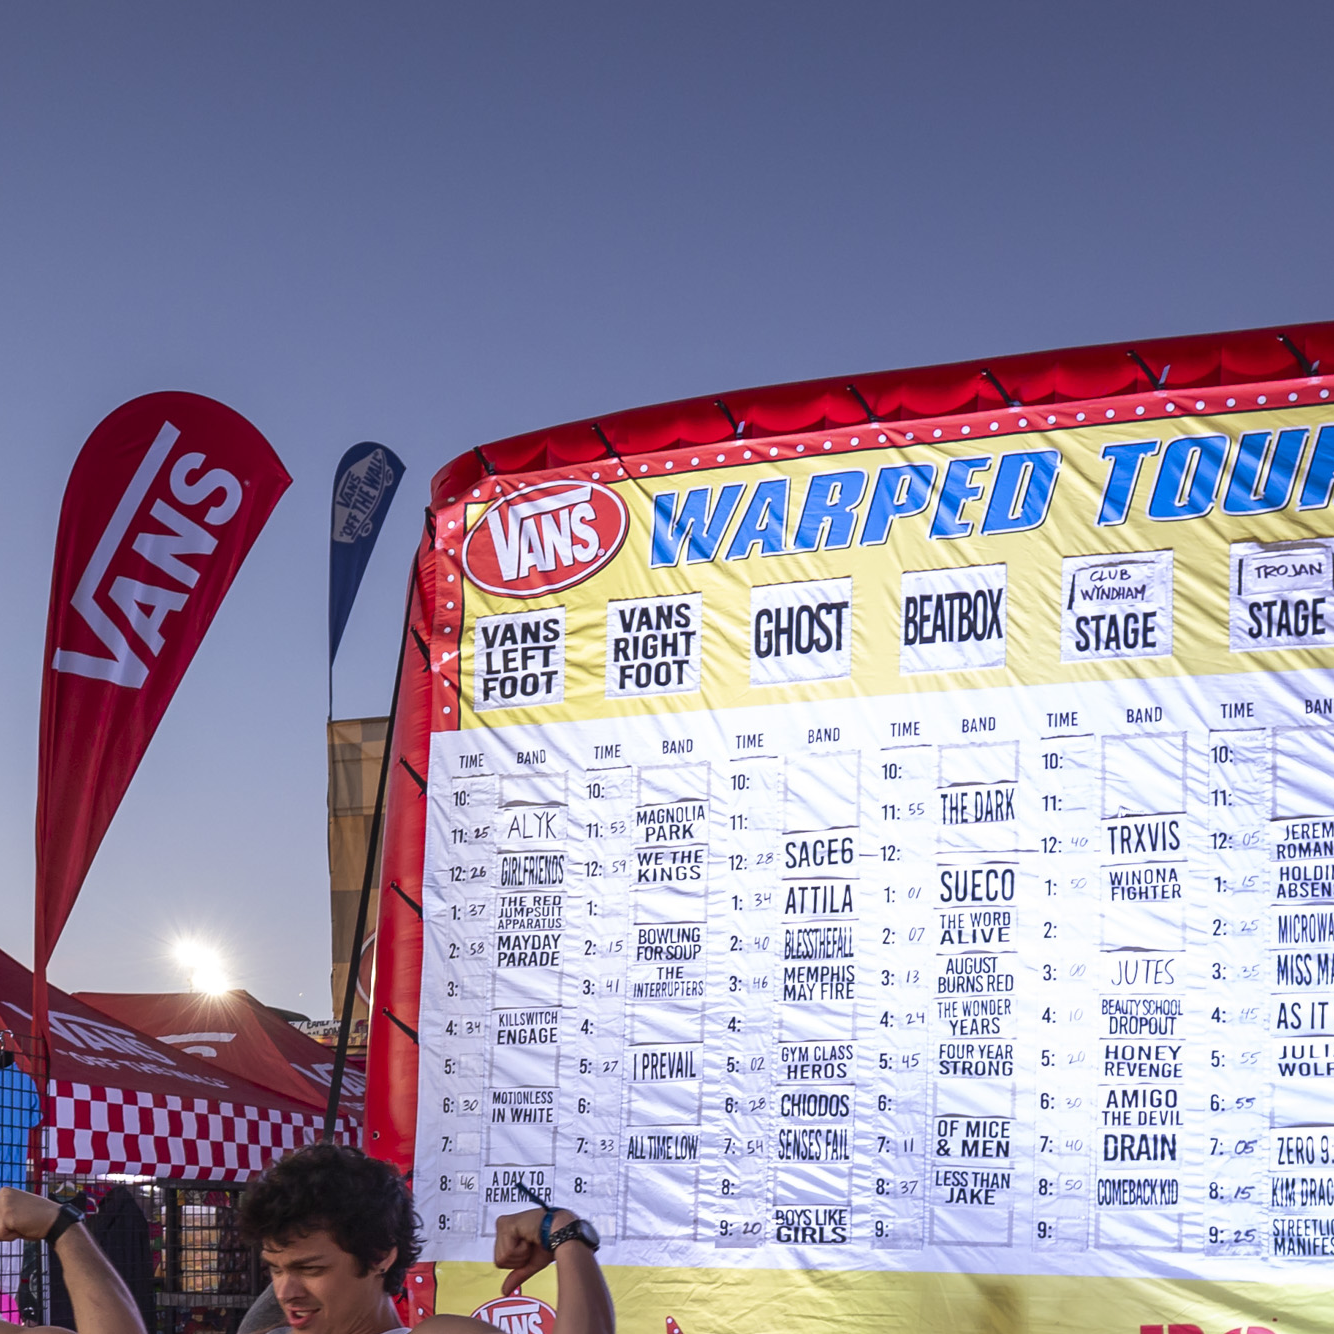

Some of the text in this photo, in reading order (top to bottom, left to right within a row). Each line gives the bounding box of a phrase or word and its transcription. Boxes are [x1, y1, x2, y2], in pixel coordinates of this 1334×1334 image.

[335, 470, 362, 509] VANS
[351, 485, 376, 515] THE
[649, 448, 1063, 570] WARPED
[487, 485, 604, 582] VANS
[53, 420, 244, 689] VANS
[1089, 569, 1132, 582] CLUB
[1254, 562, 1323, 579] TROJAN
[1080, 582, 1147, 602] WYNDHAM
[618, 602, 691, 633] VANS
[904, 588, 1004, 646] BEATBOX
[1248, 598, 1326, 639] STAGE
[482, 618, 560, 646] VANS
[755, 601, 849, 658] GHOST
[1076, 612, 1158, 652] STAGE
[613, 631, 696, 663] RIGHT
[485, 647, 558, 675] LEFT
[618, 660, 689, 690] FOOT
[482, 675, 558, 701] FOOT
[460, 750, 546, 768] TIME BAND
[636, 805, 705, 825] MAGNOLIA
[941, 788, 1015, 825] THE DARK
[508, 811, 558, 839] ALYK
[586, 822, 626, 838] 11: 53
[645, 824, 694, 842] PARK
[1108, 820, 1180, 855] TRXVIS
[638, 849, 703, 866] WE THE
[785, 837, 853, 868] SACE6
[501, 855, 565, 886] GIRLFRIENDS
[638, 865, 701, 882] KINGS
[1109, 868, 1178, 886] WINONA
[940, 869, 1015, 902] SUECO
[1111, 884, 1181, 901] FIGHTER
[501, 895, 562, 907] THE RED
[785, 885, 853, 914] ATTILA
[499, 906, 563, 917] JUMPSUIT
[498, 918, 562, 929] APPARATUS
[449, 941, 485, 958] 2: 58
[784, 965, 855, 984] MEMPHIS
[946, 957, 998, 974] AUGUST
[1111, 958, 1175, 985] JUTES
[784, 983, 854, 1001] MAY FIRE
[938, 975, 1014, 993] BURNS RED
[499, 1012, 558, 1027] KILLSWITCH
[1277, 1002, 1301, 1029] AS
[1311, 1002, 1328, 1029] IT
[497, 1028, 558, 1045] ENGAGE
[782, 1045, 853, 1062] GYM CLASS
[1105, 1045, 1181, 1061] HONEY
[633, 1052, 696, 1081] I PREVAIL
[787, 1063, 847, 1079] HEROS
[939, 1061, 1013, 1076] STRONG
[1105, 1063, 1182, 1078] REVENGE
[781, 1094, 850, 1117] CHIODOS
[1106, 1089, 1178, 1108] AMIGO
[936, 1139, 1010, 1158] & MEN
[1104, 1134, 1176, 1161] DRAIN
[945, 1188, 995, 1205] JAKE
[776, 1226, 847, 1243] GIRLS
